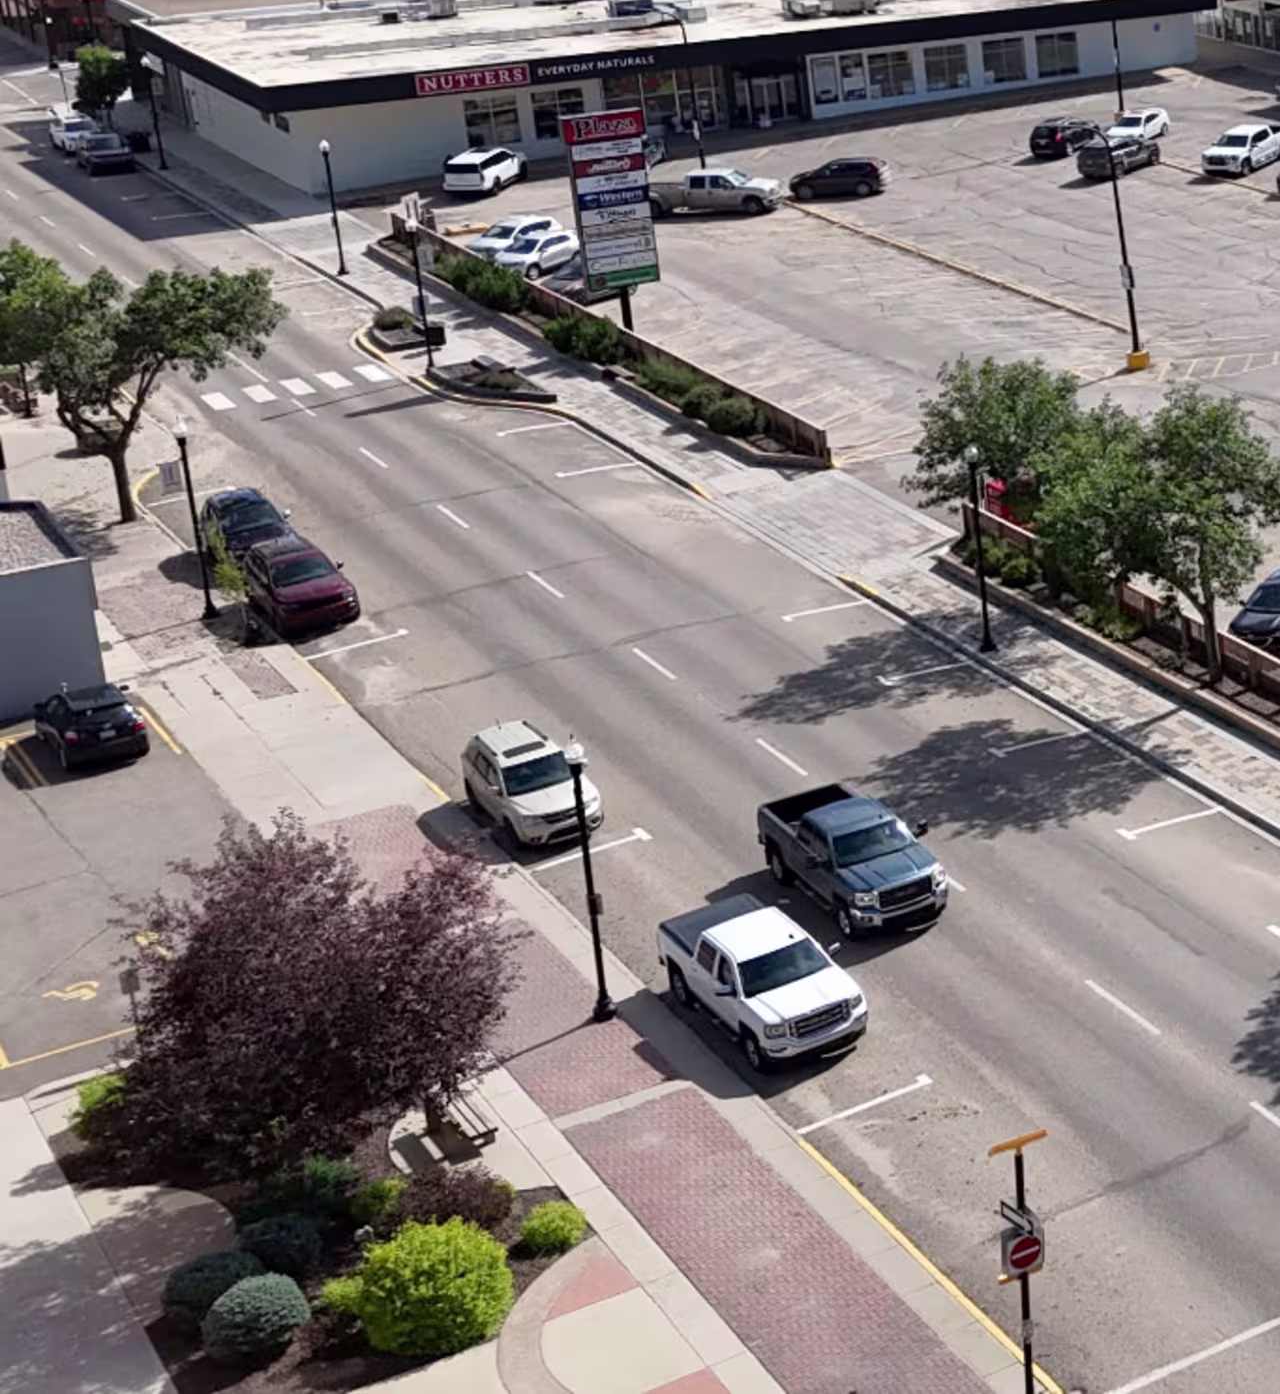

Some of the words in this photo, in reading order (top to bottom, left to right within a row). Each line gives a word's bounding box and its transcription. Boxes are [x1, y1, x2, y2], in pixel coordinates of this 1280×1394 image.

[537, 61, 595, 77] EVERYDAY
[597, 54, 655, 70] NATURALS
[423, 67, 524, 92] NUTTERS
[571, 116, 637, 141] Plaza
[599, 189, 644, 203] Western
